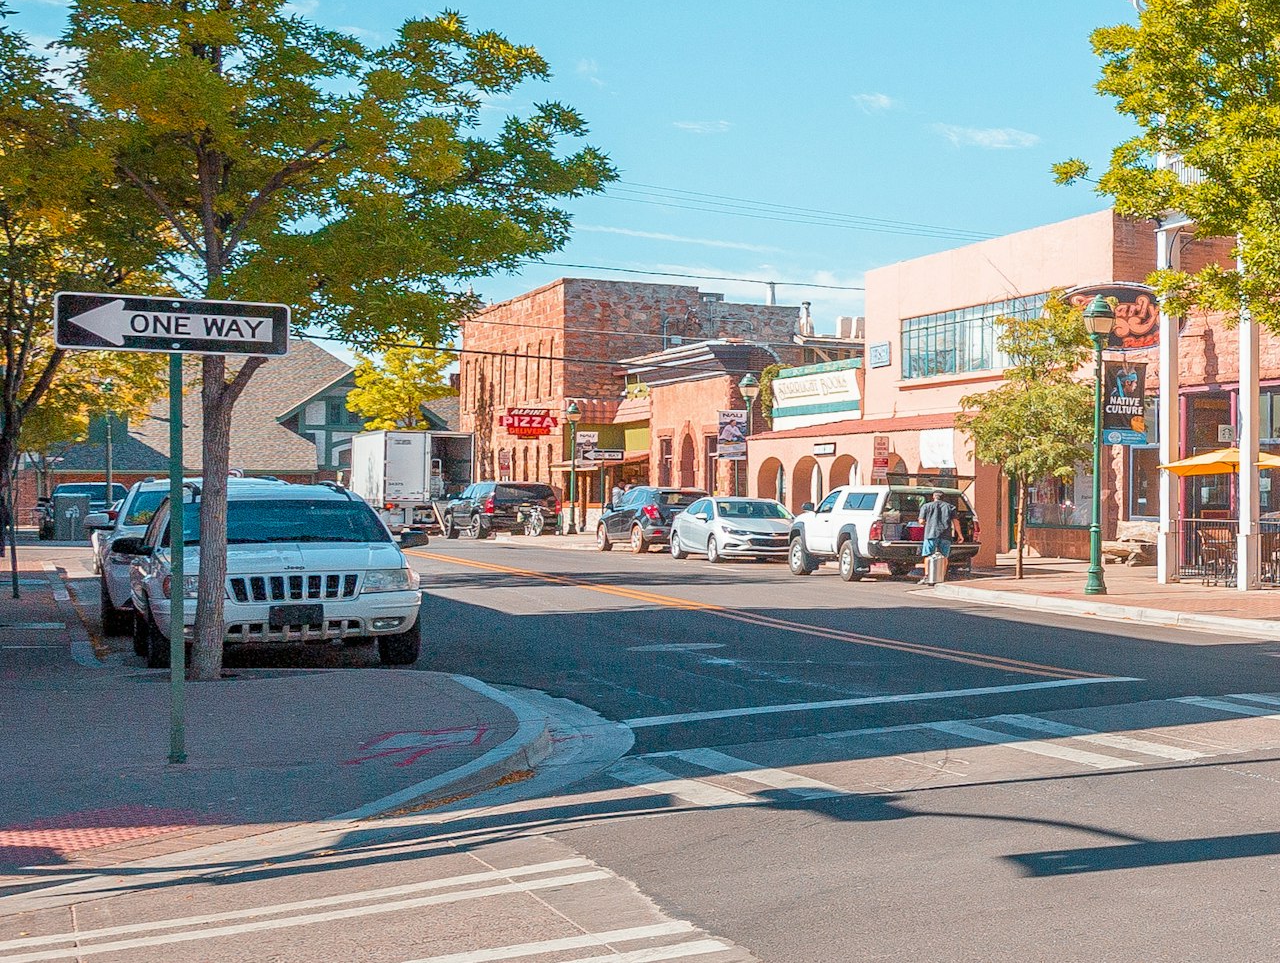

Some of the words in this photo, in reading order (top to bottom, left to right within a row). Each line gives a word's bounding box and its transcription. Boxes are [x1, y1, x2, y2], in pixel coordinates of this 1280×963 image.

[130, 314, 192, 335] ONE
[203, 317, 265, 339] WAY
[1109, 396, 1141, 406] NATIVE
[1105, 405, 1144, 415] CULTURE
[502, 416, 555, 427] PIZZA
[509, 427, 549, 435] DELIVERY
